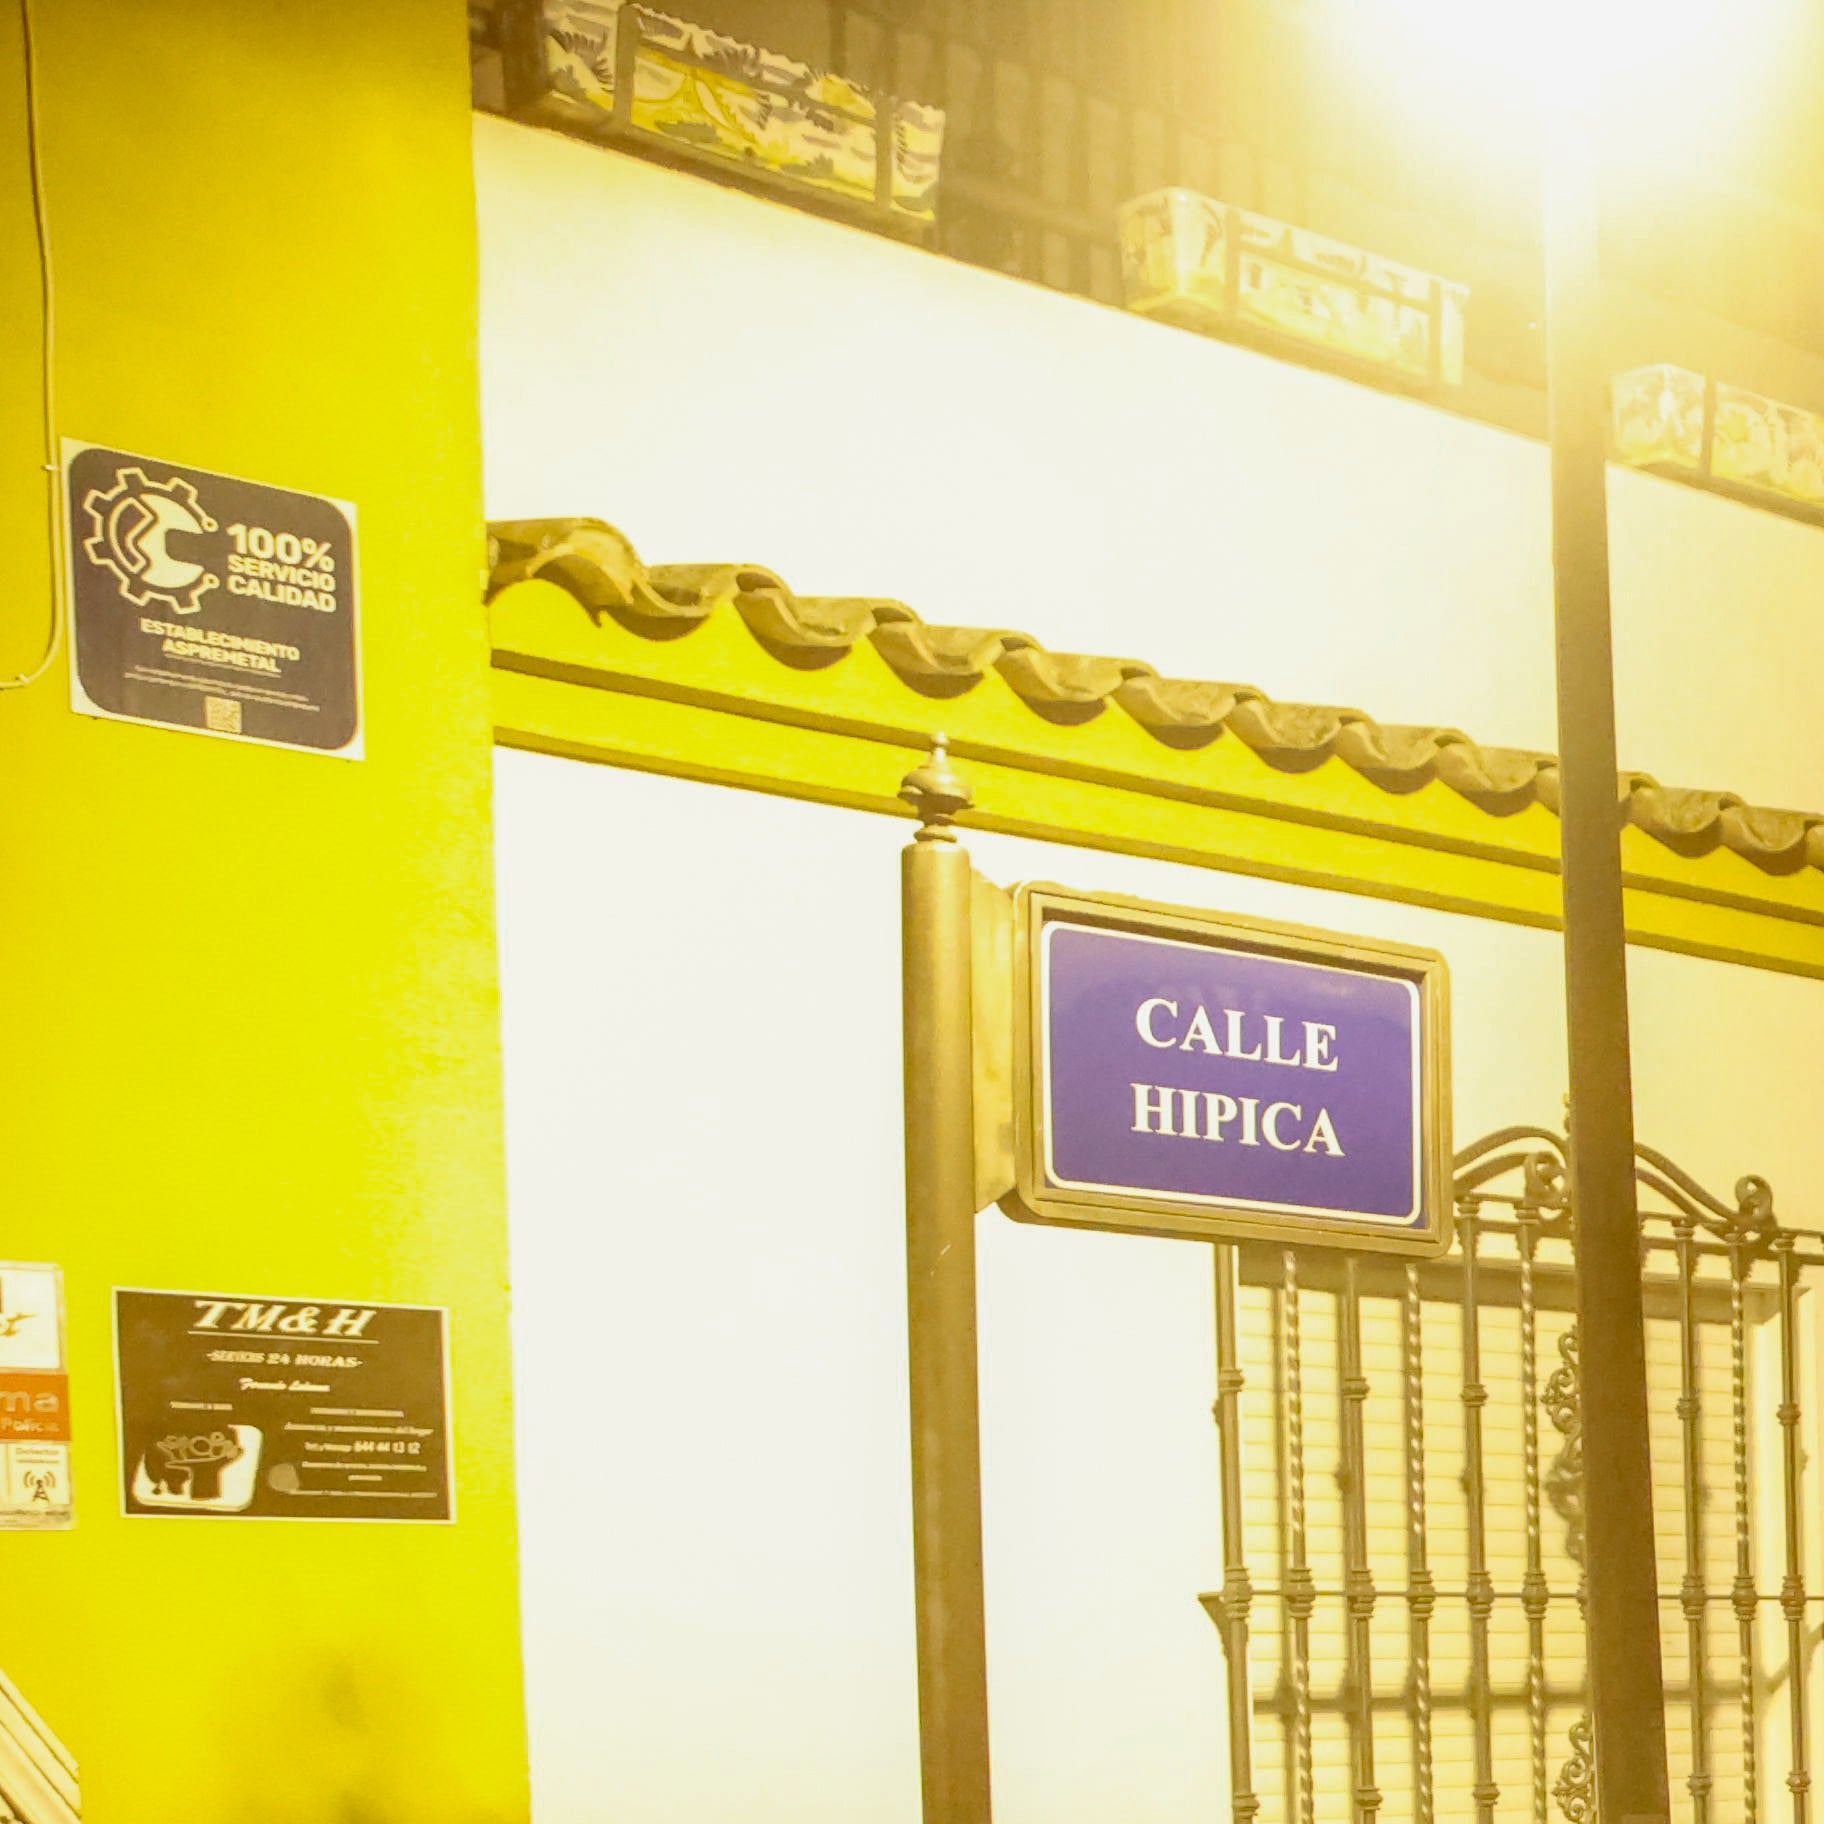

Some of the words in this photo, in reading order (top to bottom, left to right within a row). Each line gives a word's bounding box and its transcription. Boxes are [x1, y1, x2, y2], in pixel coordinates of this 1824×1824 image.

[226, 523, 335, 572] 100%
[227, 554, 336, 592] SERVICIO
[228, 575, 336, 612] CALIDAD
[140, 617, 300, 661] ESTABLECIMIENTO
[1135, 998, 1339, 1072] CALLE
[1130, 1083, 1345, 1158] HIPICA
